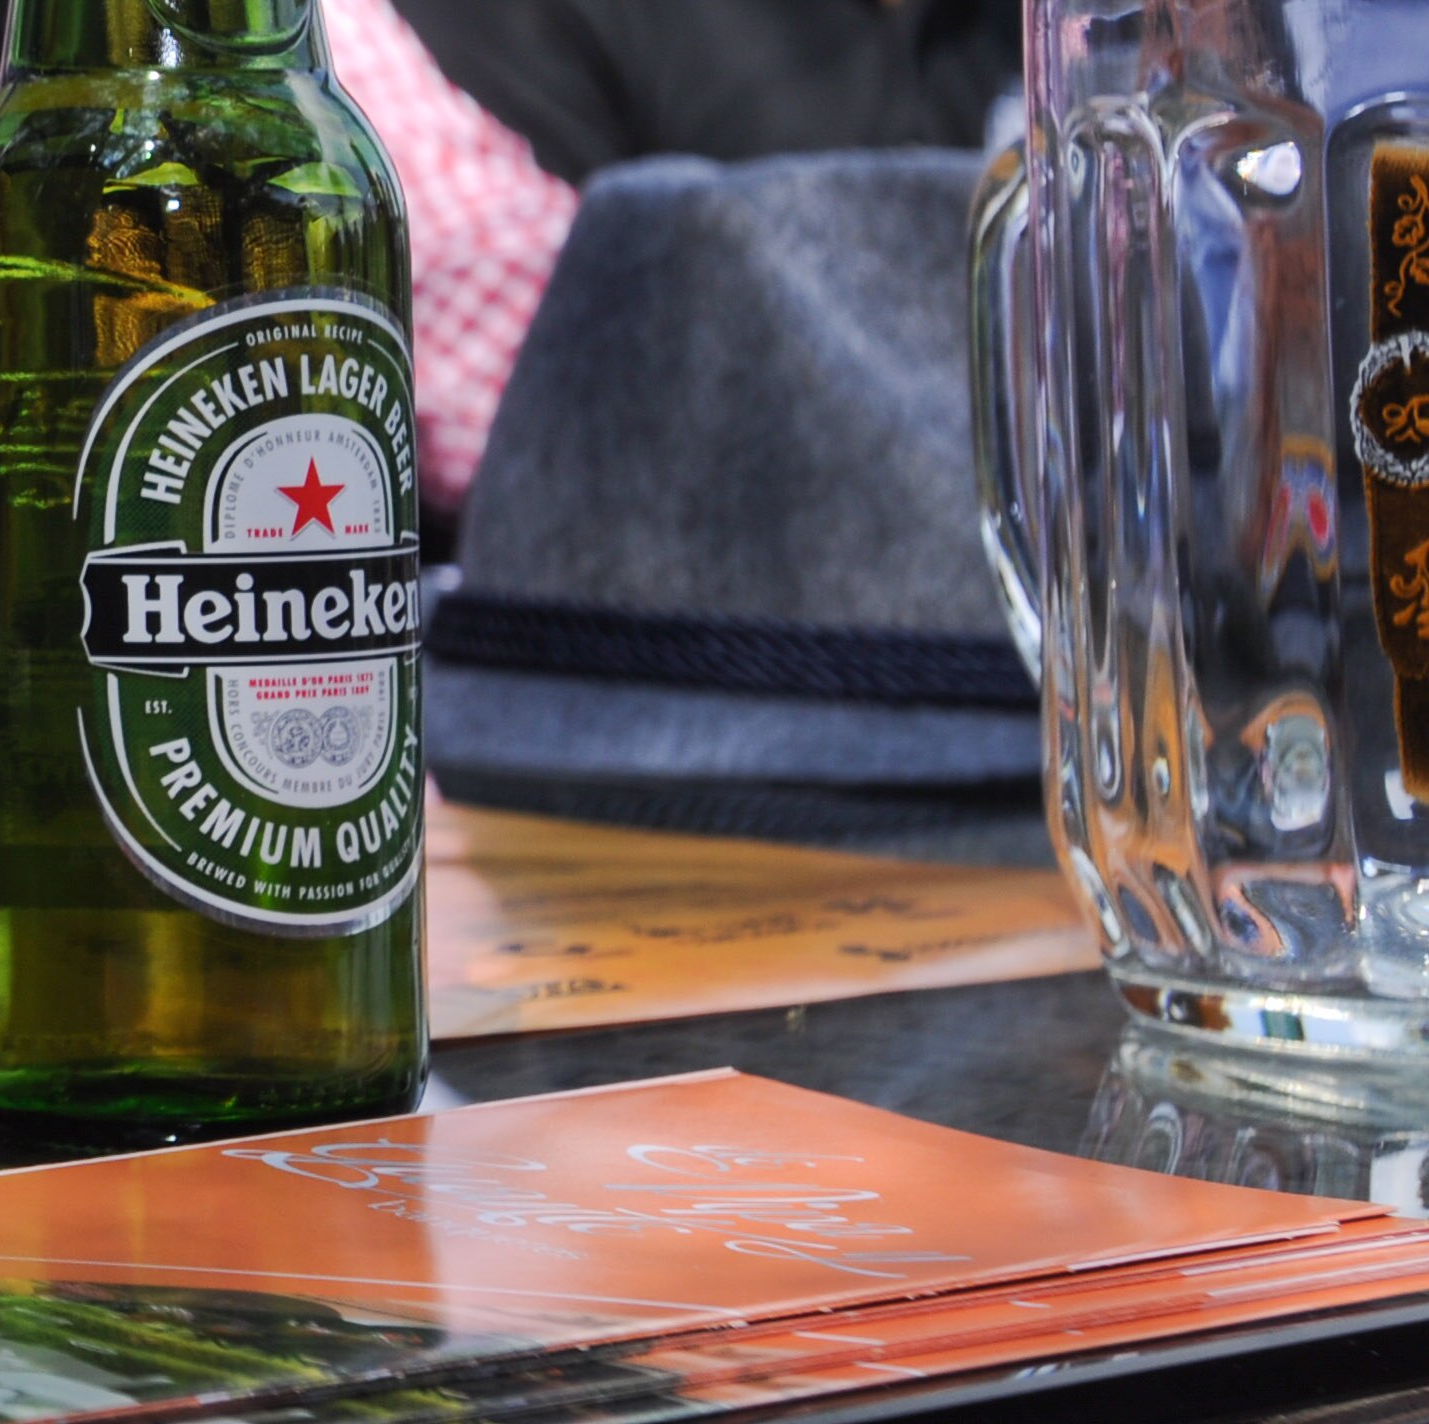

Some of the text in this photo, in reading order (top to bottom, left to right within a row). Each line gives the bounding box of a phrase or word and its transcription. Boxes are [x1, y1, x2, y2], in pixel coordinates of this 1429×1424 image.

[246, 324, 363, 346] ORIGINAL RECIPE
[140, 354, 413, 504] HEINEKEN LAGER BEER
[246, 524, 370, 539] TRADE MARK
[121, 572, 420, 644] Heineken
[249, 677, 297, 688] MEDAILLE
[328, 674, 353, 684] PARIS
[256, 689, 290, 701] GRAND
[295, 688, 317, 698] PRIX
[321, 686, 347, 697] PARIS
[144, 699, 172, 715] EST.
[228, 680, 240, 716] HORS
[230, 724, 278, 786] CONCOURS
[148, 722, 418, 868] PREMIUM QUALITY
[282, 777, 332, 794] MEMBRE
[187, 852, 246, 889] BREWED
[254, 880, 291, 899] WITH
[299, 880, 354, 900] PASSION
[359, 872, 379, 892] FOR
